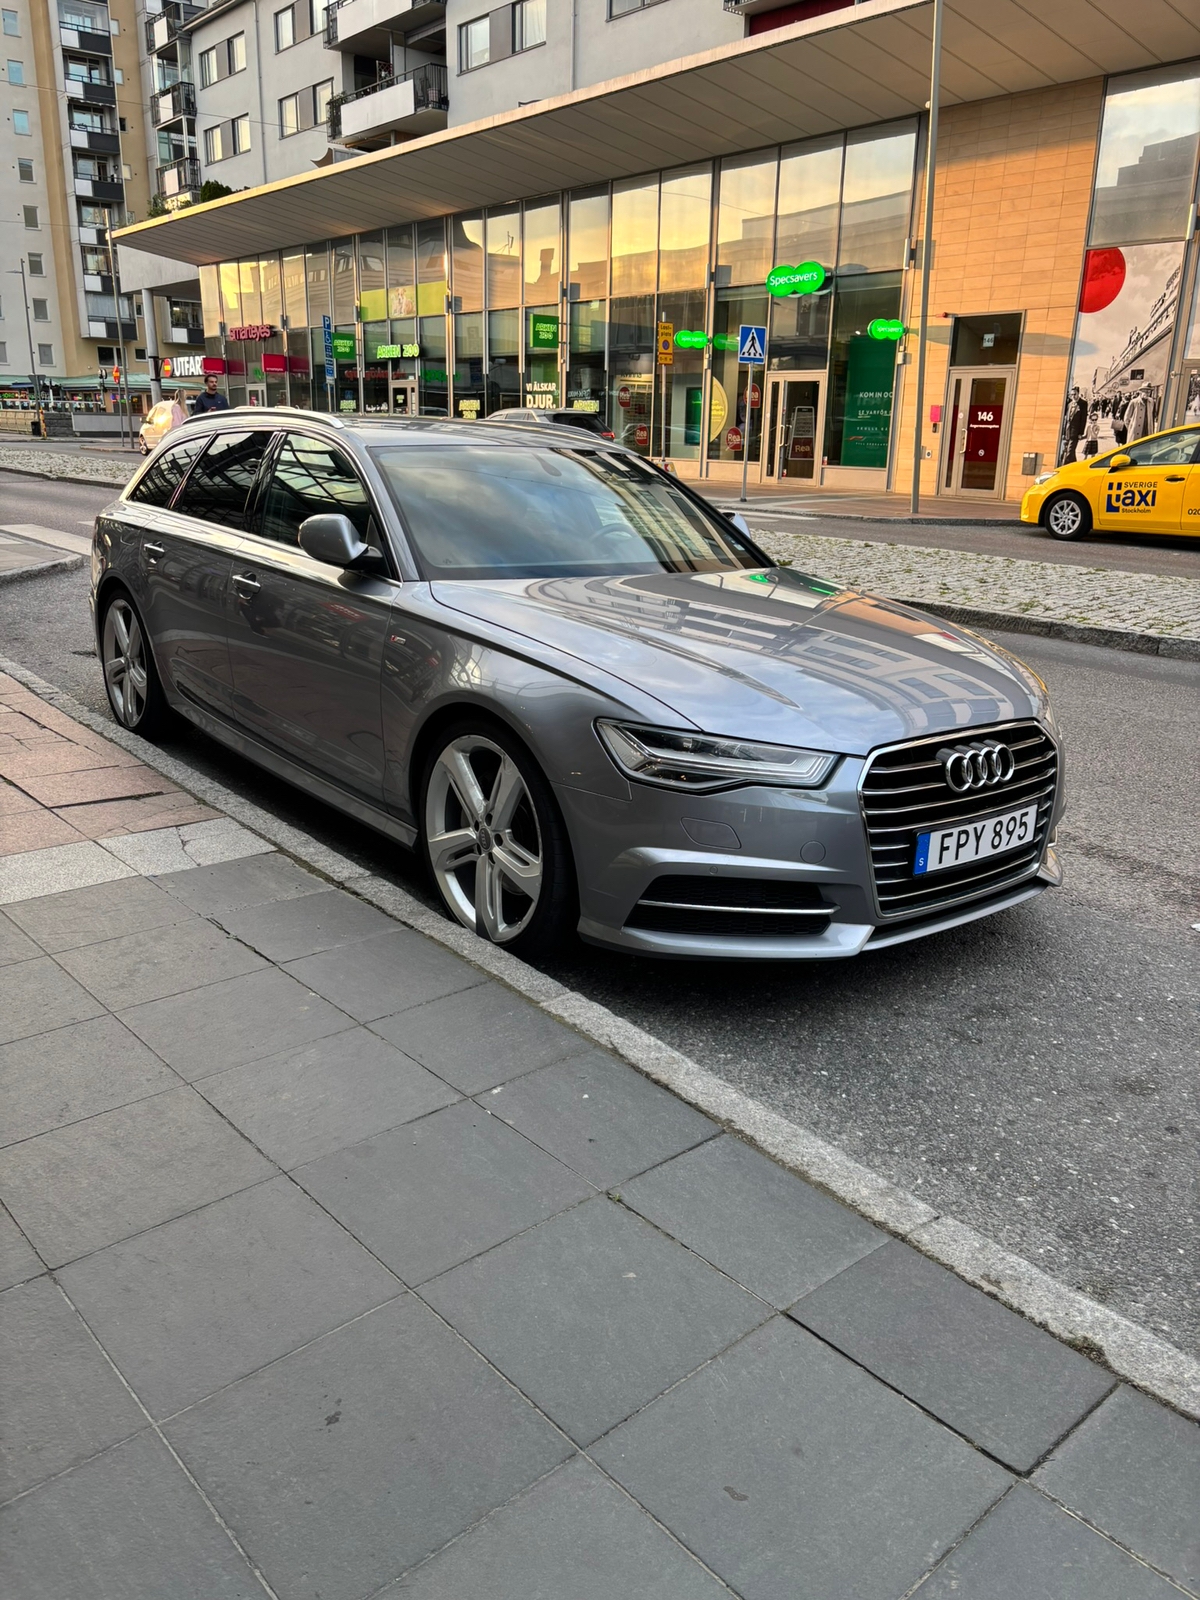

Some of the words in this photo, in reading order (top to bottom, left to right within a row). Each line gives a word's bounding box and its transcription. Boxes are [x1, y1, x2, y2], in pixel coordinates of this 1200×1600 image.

[769, 271, 818, 286] Specsavers
[229, 324, 271, 341] smarteyes
[534, 323, 557, 332] ARKEN
[876, 325, 903, 333] Specsavers
[539, 332, 554, 340] ZOO
[376, 345, 401, 359] ARKEN
[402, 344, 420, 357] ZOO
[526, 383, 533, 391] VI
[533, 381, 556, 391] ÄLSKAR
[859, 391, 875, 399] KOM
[459, 400, 481, 410] ARKEN
[526, 394, 556, 409] DJUR.
[977, 411, 994, 422] 146
[636, 429, 647, 437] Rea
[727, 433, 741, 442] Rea
[795, 445, 811, 453] Rea
[1123, 481, 1158, 489] SVERIGE
[938, 824, 987, 865] FPY
[990, 811, 1030, 850] 895
[918, 857, 925, 867] S
